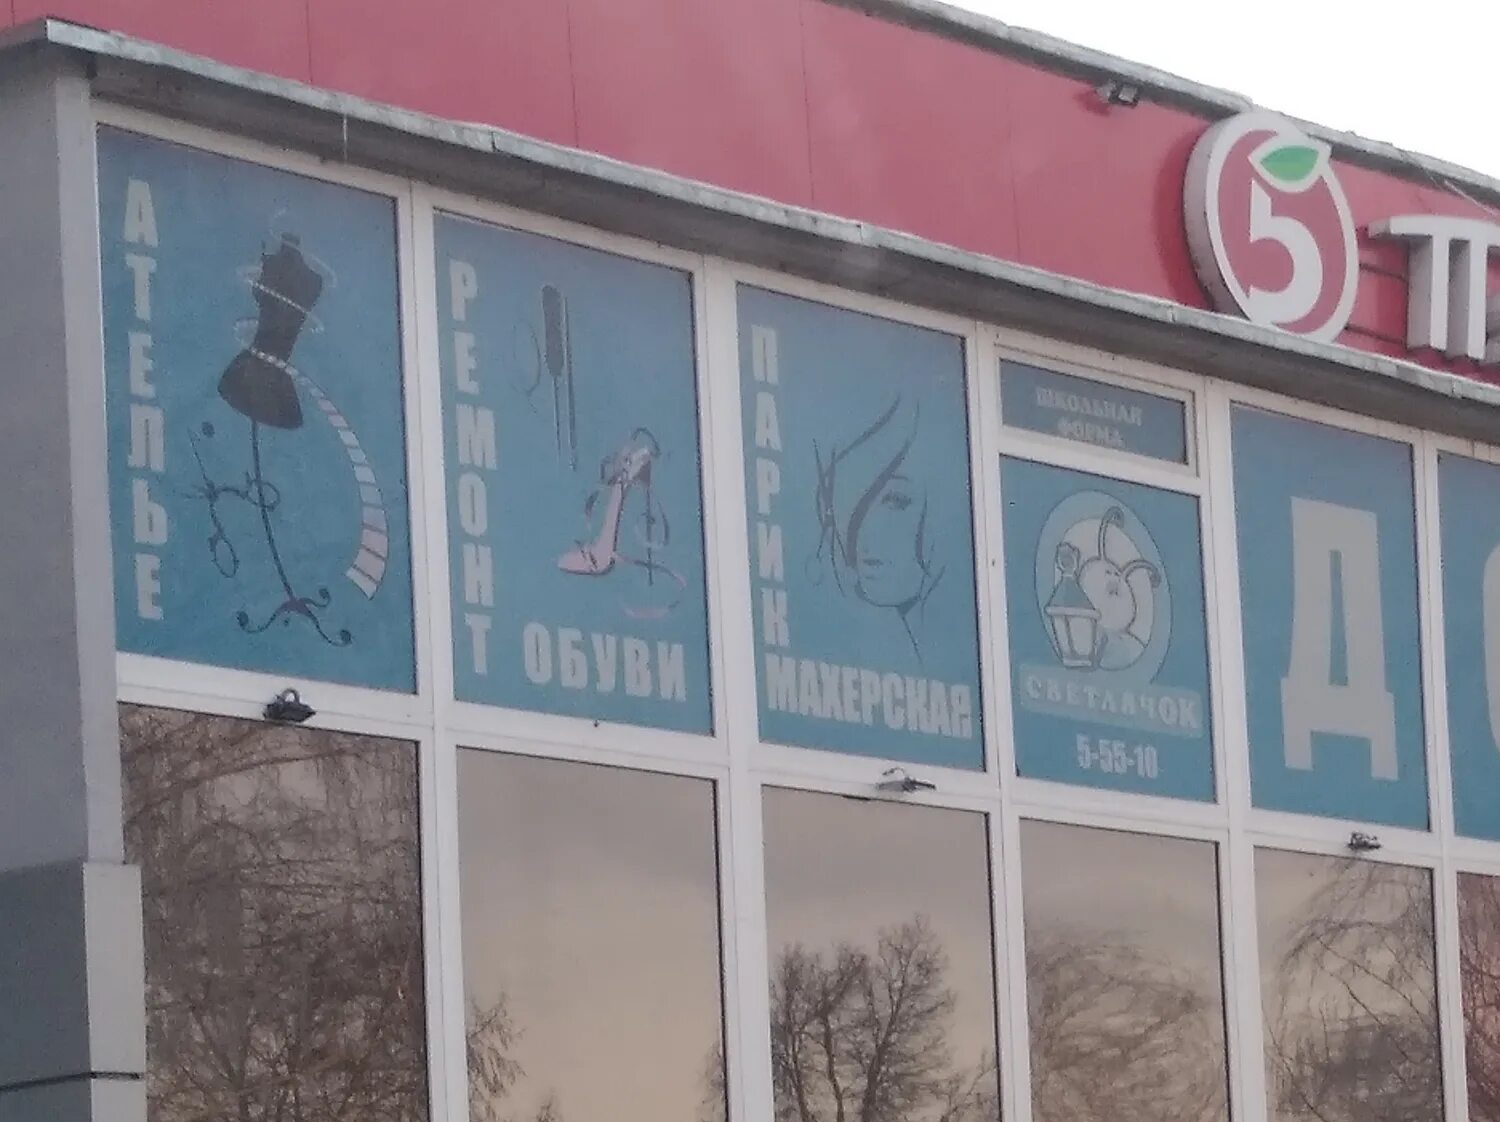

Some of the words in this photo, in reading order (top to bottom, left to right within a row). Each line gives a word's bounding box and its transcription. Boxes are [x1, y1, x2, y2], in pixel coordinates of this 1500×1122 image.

[122, 178, 168, 621] АТЕЛЬЕ
[447, 259, 497, 675] РЕМОНТ
[750, 324, 792, 648] ПАРИК
[522, 621, 687, 701] ОБУВИ
[764, 655, 973, 740] МАХЕРСКАЯ
[1025, 674, 1199, 729] СВЕТЛЯЧОК
[1075, 732, 1160, 780] 5-55-10
